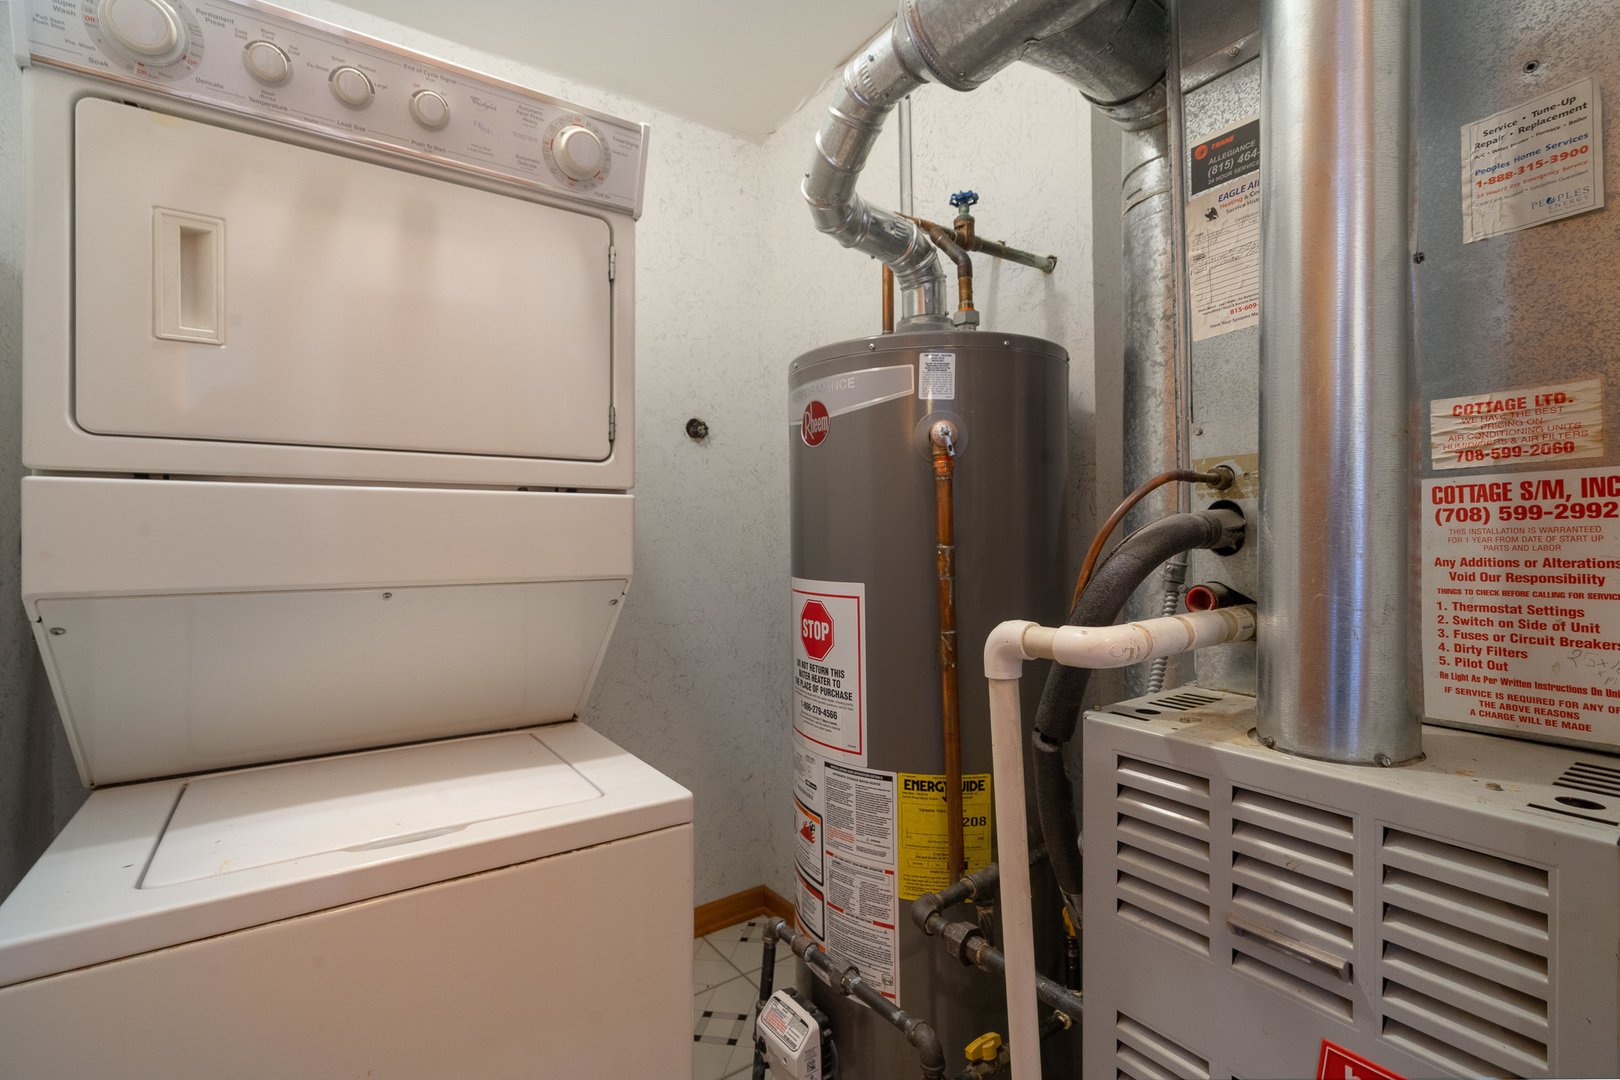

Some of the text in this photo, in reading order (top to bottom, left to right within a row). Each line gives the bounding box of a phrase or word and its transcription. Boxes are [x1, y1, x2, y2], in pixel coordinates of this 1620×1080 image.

[53, 5, 76, 16] Wash
[196, 8, 234, 24] Permanent
[205, 17, 225, 28] Press
[88, 57, 109, 68] Soak
[423, 69, 438, 78] Cycle
[196, 77, 224, 89] Delicate
[248, 96, 288, 112] Temperature
[1483, 96, 1576, 137] Service Tune-Up
[337, 120, 366, 133] Load Size
[1475, 102, 1588, 150] Repair Replacement
[1535, 125, 1561, 137] Furnace
[1568, 116, 1587, 126] Boiler
[1208, 140, 1256, 165] ALLEGIANCE
[1475, 132, 1589, 176] Peoples Home Services
[1208, 157, 1234, 178] (815)
[1476, 145, 1589, 188] 1-888-315-3900
[1523, 169, 1560, 184] Emergency
[1562, 160, 1588, 172] Service
[1215, 170, 1232, 182] HOUR
[1218, 185, 1246, 203] EAGLE
[1220, 196, 1243, 209] Heating
[1226, 202, 1246, 214] Service
[1452, 392, 1574, 416] COTTAGE LTD.
[804, 402, 828, 440] Rheem
[1480, 413, 1507, 423] HAVE
[1510, 410, 1532, 419] THE
[1535, 406, 1564, 415] BEST
[1448, 422, 1582, 442] AIR CONDITIONING UNITS
[1480, 420, 1523, 430] PRICING
[1542, 430, 1589, 441] FILTERS
[1454, 441, 1575, 463] 708-599-2060
[1432, 476, 1620, 505] COTTAGE S/M, INC
[1435, 502, 1619, 526] (708) 599-2992
[1539, 526, 1602, 534] WARRANTEED
[1434, 557, 1456, 569] Any
[1460, 557, 1520, 568] Additions
[1524, 559, 1538, 568] or
[1449, 572, 1606, 587] Void Our Responsibility
[1436, 602, 1585, 619] 1. Thermostat Settings
[803, 619, 829, 641] STOP
[1437, 615, 1601, 634] 2. Switch on Side of Unit
[1438, 629, 1449, 638] 3.
[1454, 630, 1489, 642] Fuses
[1493, 634, 1506, 643] or
[1510, 633, 1555, 646] Circuit
[1438, 642, 1528, 659] 4. Dirty Filters
[810, 663, 829, 676] RETURN
[831, 668, 845, 679] THIS
[1439, 656, 1509, 672] 5. Pilot Out
[811, 674, 831, 686] HEATER
[832, 679, 841, 688] TO
[1440, 671, 1449, 679] Re
[1451, 672, 1469, 682] Light
[1471, 675, 1481, 683] As
[1483, 676, 1498, 685] Per
[1500, 677, 1532, 689] Written
[1534, 681, 1588, 695] Instructions
[1591, 687, 1603, 696] On
[800, 679, 812, 692] PLACE
[813, 684, 819, 693] OF
[820, 686, 853, 701] PURCHASE
[1455, 688, 1492, 698] SERVICE
[1507, 694, 1555, 706] REQUIRED
[1559, 700, 1579, 709] FOR
[1583, 703, 1604, 712] ANY
[1608, 706, 1620, 714] OF
[1479, 700, 1580, 720] THE ABOVE REASONS
[1479, 710, 1516, 722] CHARGE
[1519, 716, 1542, 726] WILL
[1545, 719, 1557, 727] BE
[1561, 722, 1592, 732] MADE
